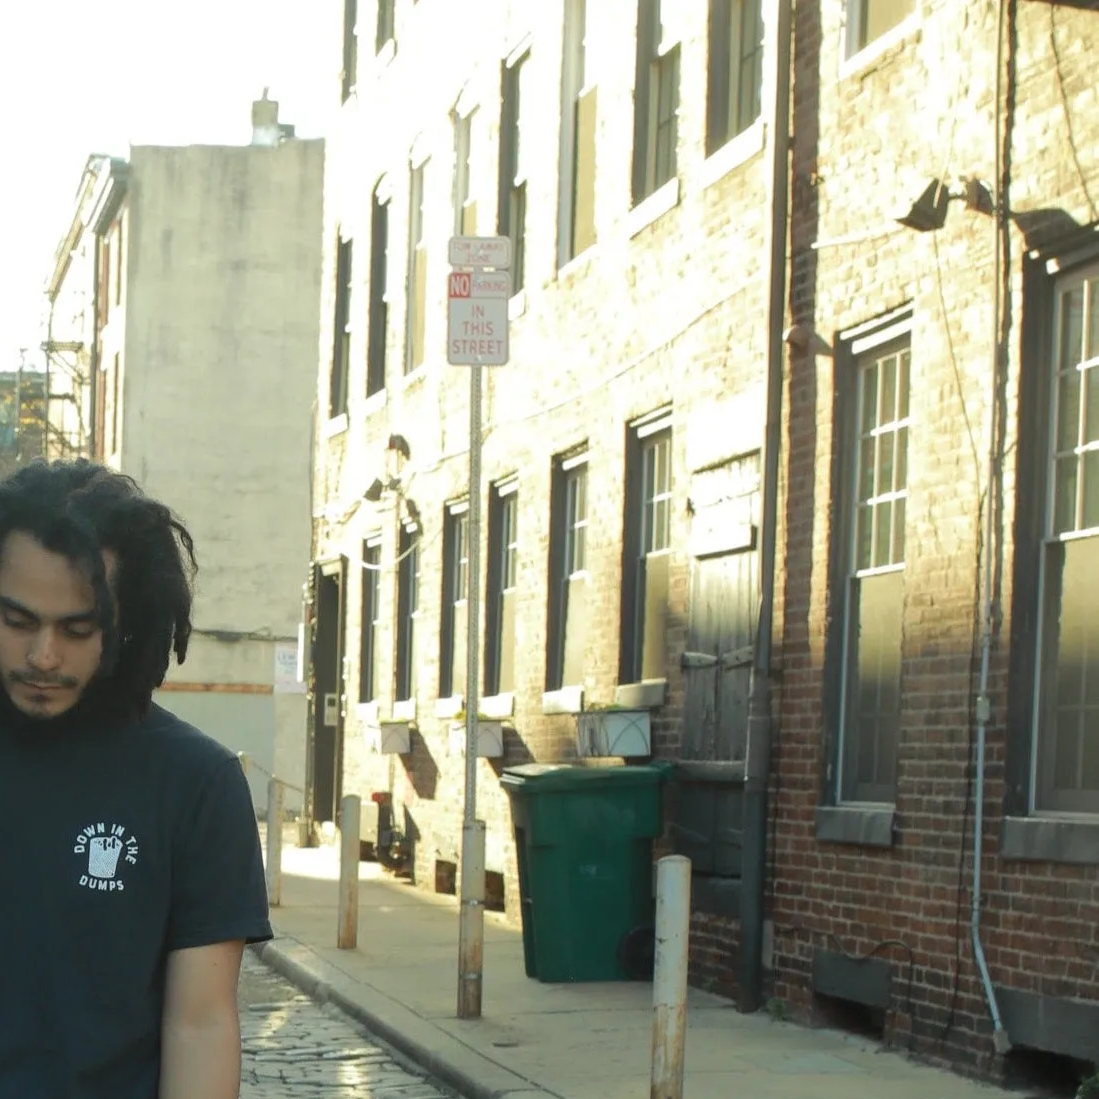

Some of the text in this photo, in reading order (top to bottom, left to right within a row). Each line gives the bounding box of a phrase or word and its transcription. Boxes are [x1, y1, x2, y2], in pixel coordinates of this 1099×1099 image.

[450, 274, 507, 297] NO PARKING
[472, 305, 484, 318] IN
[462, 321, 494, 336] THIS
[451, 340, 504, 355] STREET
[73, 822, 139, 865] DOWN IN THE
[79, 874, 125, 891] DUMPS
